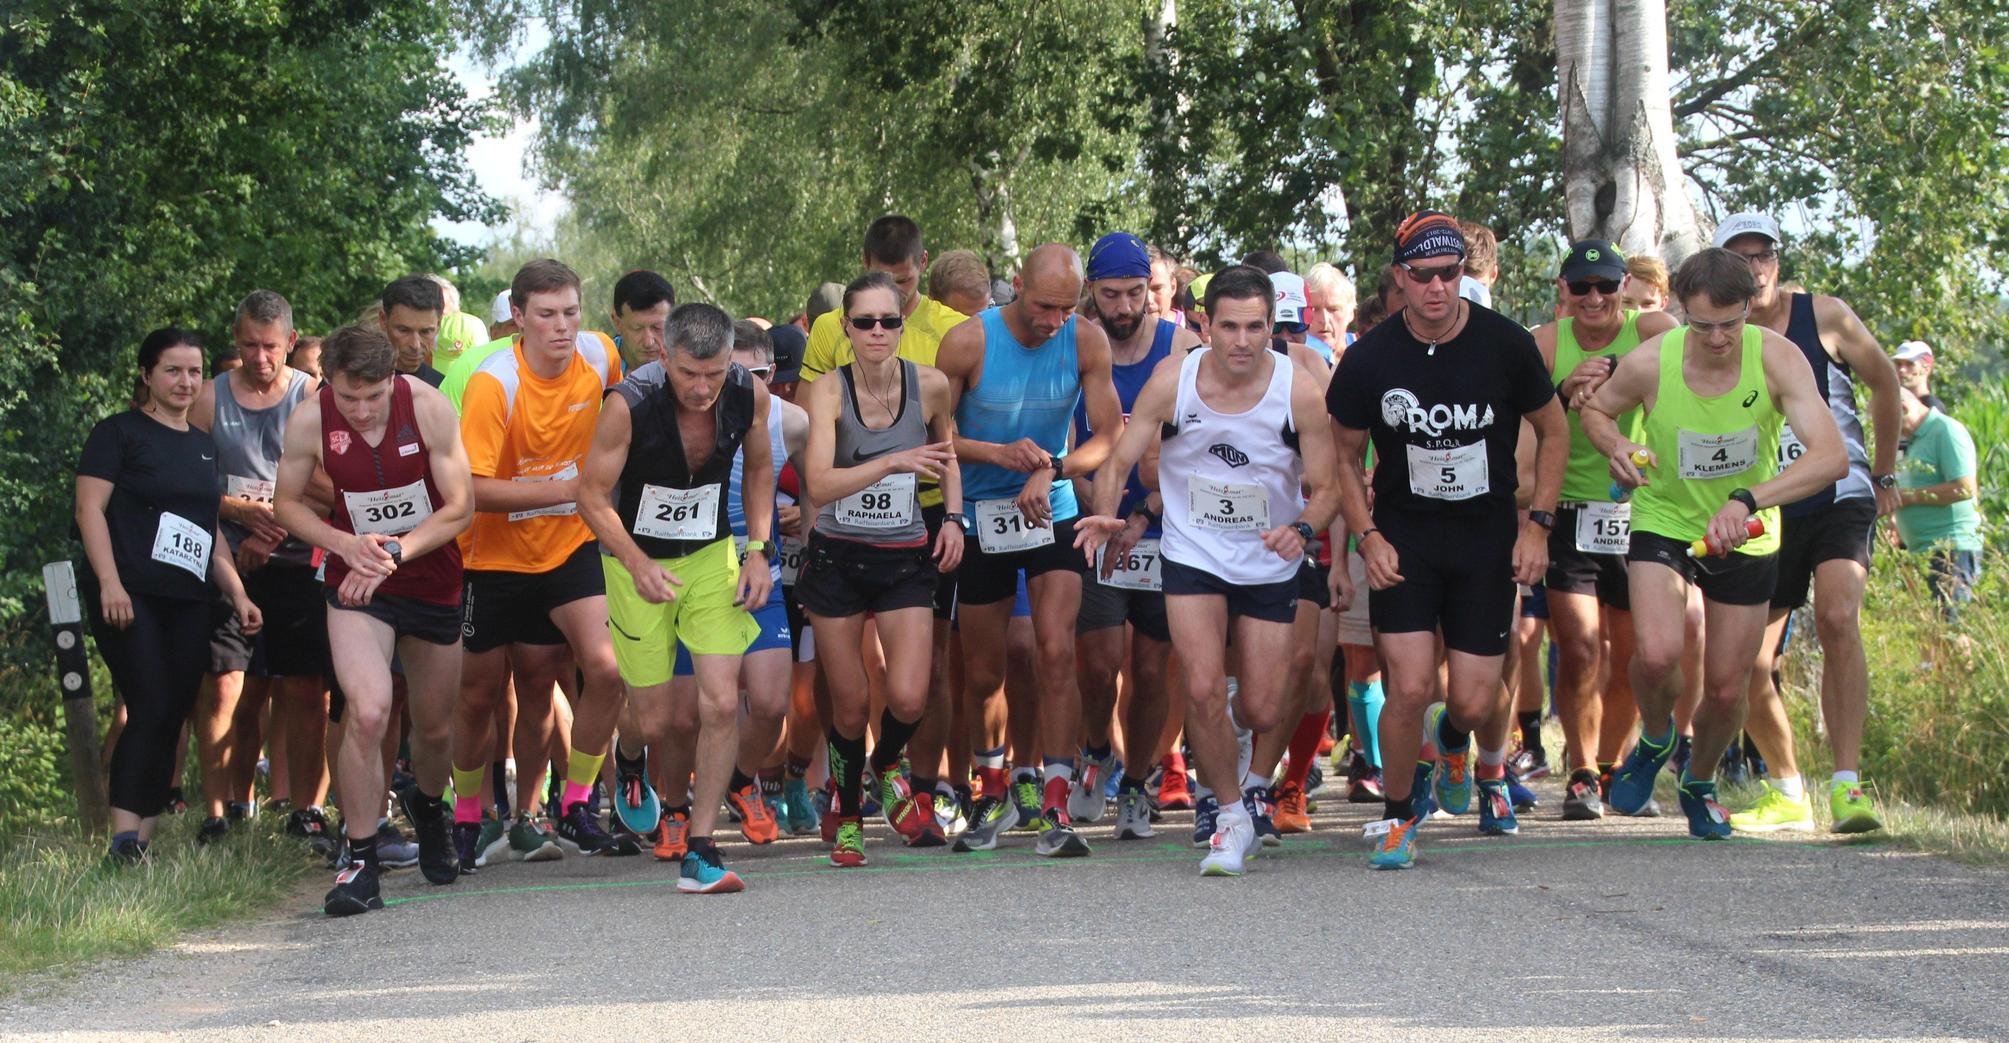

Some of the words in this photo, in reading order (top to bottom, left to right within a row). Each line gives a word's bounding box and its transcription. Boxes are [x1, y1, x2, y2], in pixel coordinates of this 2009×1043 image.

[1408, 403, 1495, 437] ROMA
[1711, 447, 1729, 462] 4
[1694, 459, 1746, 472] KLEMENS
[1440, 466, 1457, 484] 5
[1433, 484, 1464, 493] JOHN
[861, 492, 892, 510] 98
[1218, 498, 1235, 515] 3
[365, 501, 417, 523] 302
[655, 502, 700, 522] 261
[847, 509, 903, 520] RAPHAELA
[1203, 512, 1254, 524] ANDREAS
[1593, 518, 1631, 536] 157
[172, 532, 203, 559] 188
[1593, 537, 1630, 545] ANDRE
